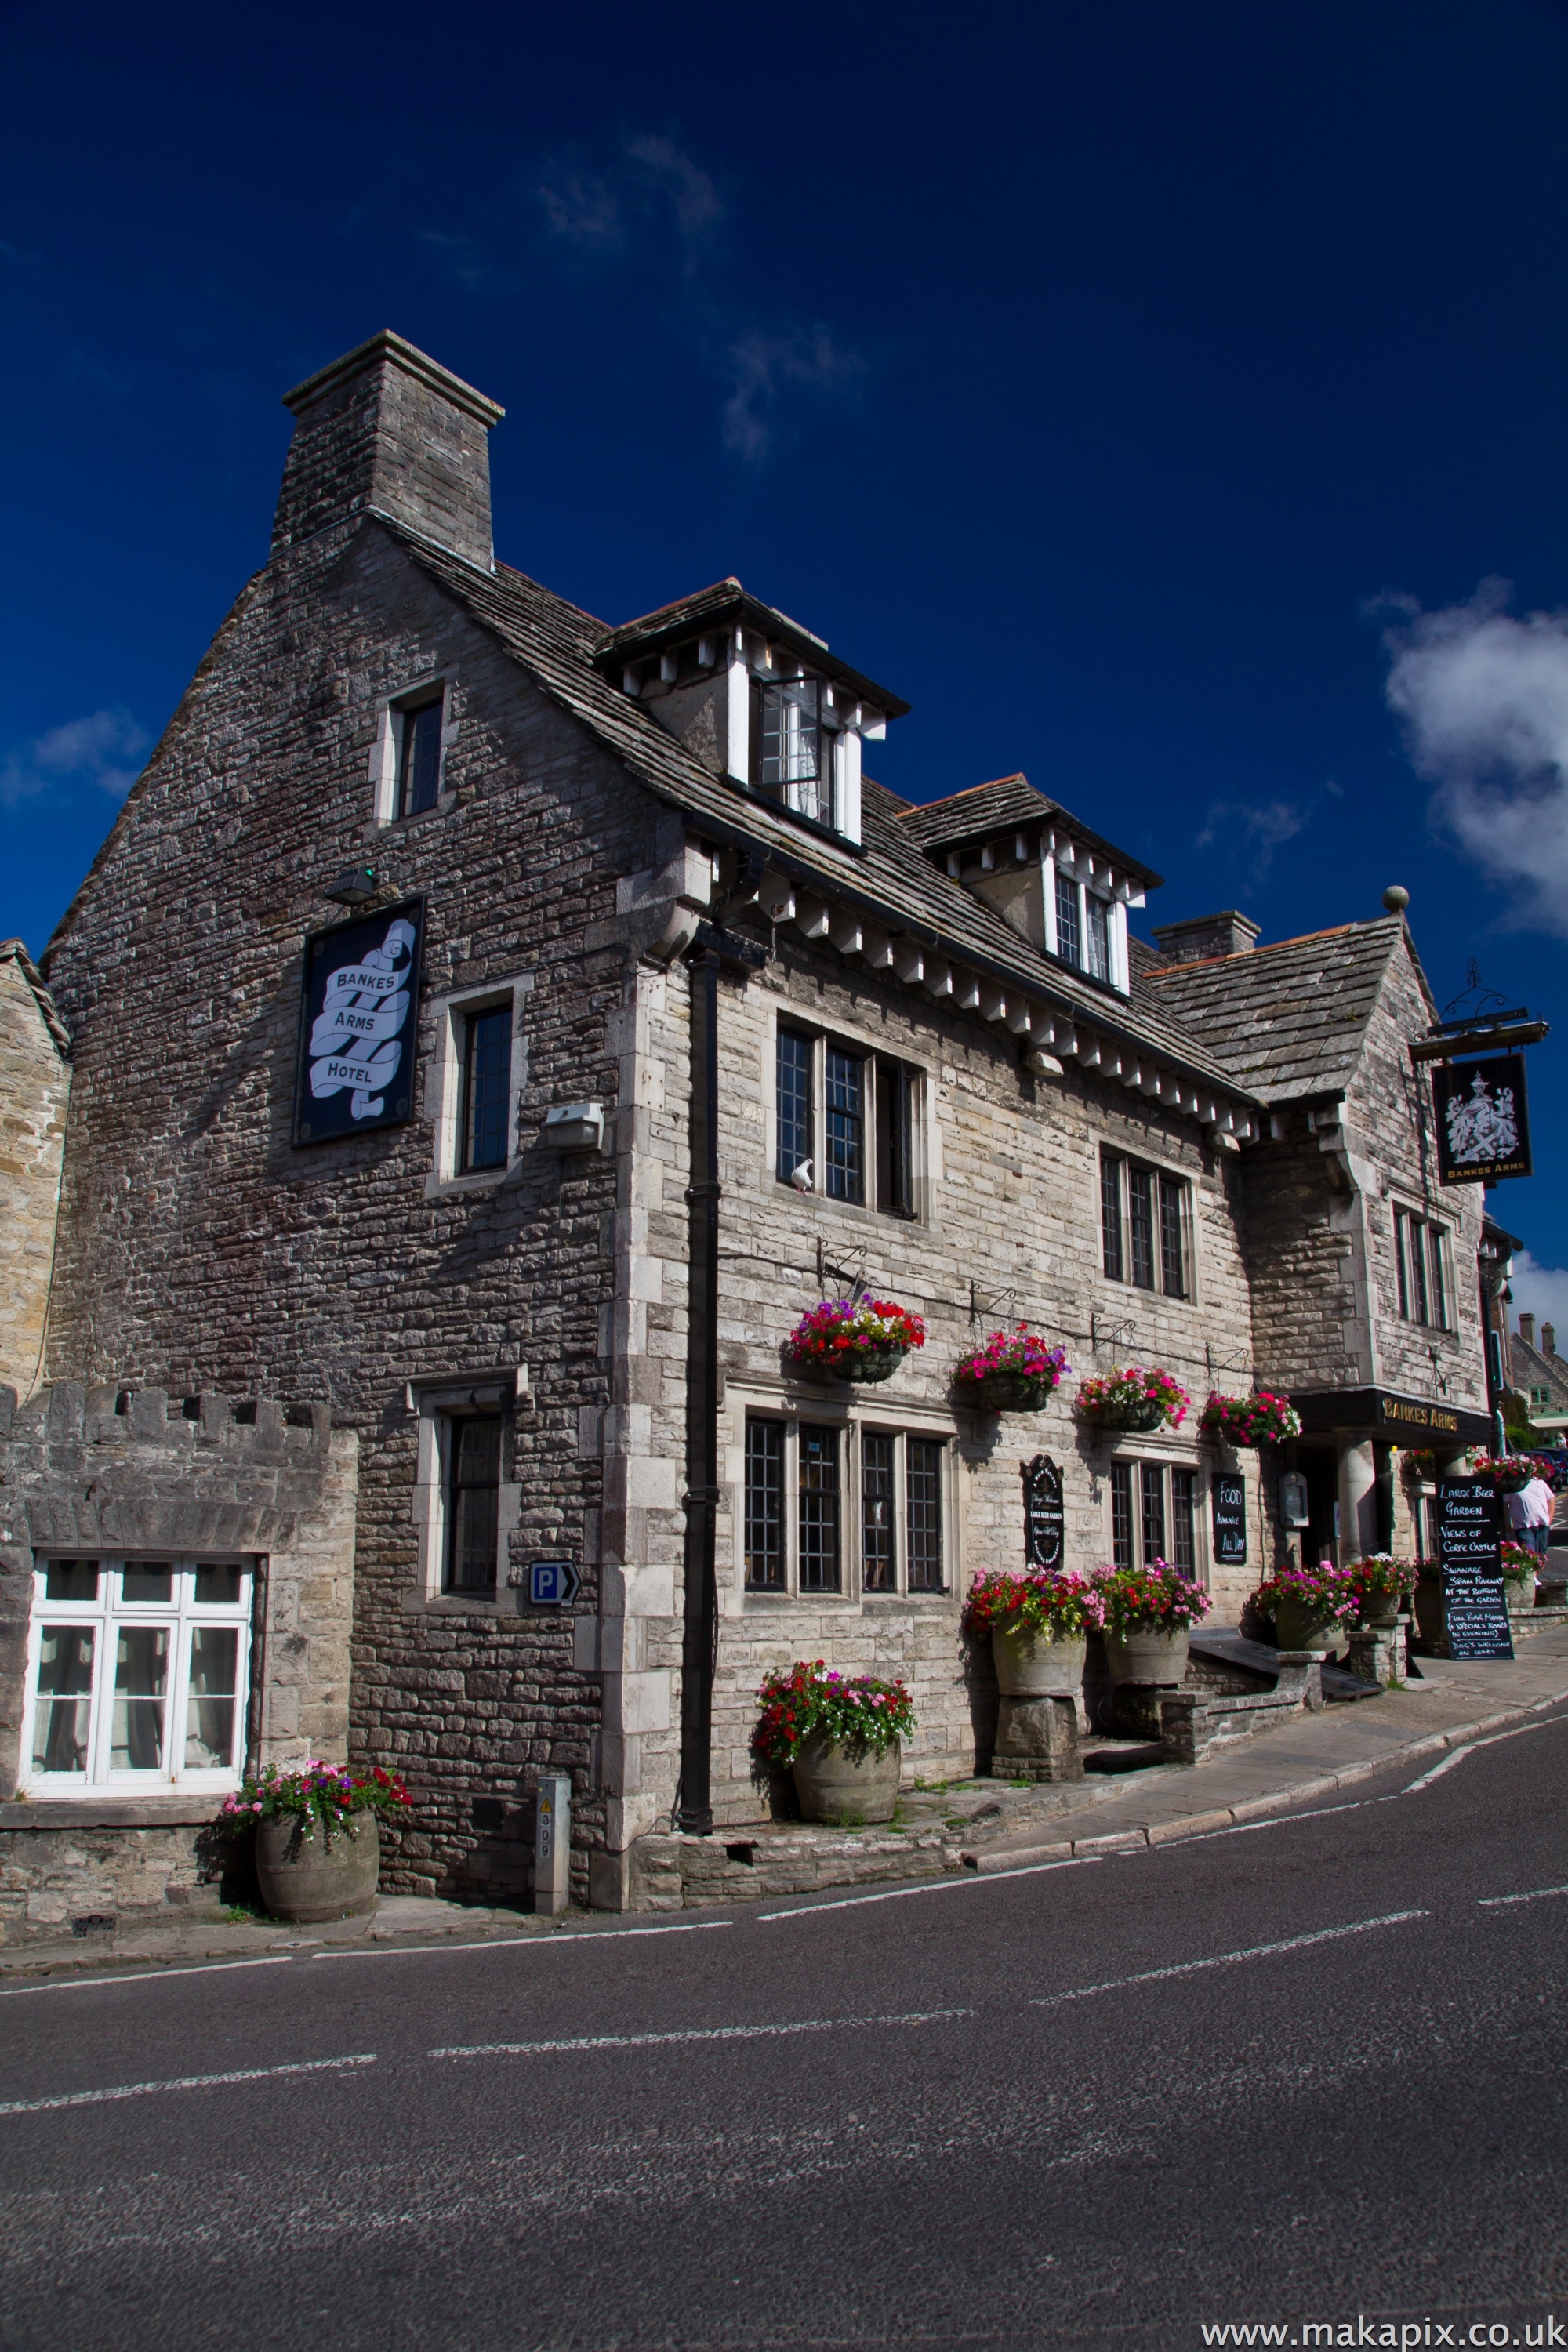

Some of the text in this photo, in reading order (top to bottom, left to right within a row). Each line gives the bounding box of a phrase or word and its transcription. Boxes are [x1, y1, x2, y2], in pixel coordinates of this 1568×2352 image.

[337, 973, 395, 989] BANKES
[334, 1011, 376, 1031] ARMS
[328, 1062, 372, 1083] HOTEL
[1447, 1162, 1525, 1178] BANKES ARMS
[1384, 1398, 1458, 1432] BANKES ARMS
[1219, 1480, 1242, 1505] FOOD
[1439, 1484, 1495, 1498] LARGE BEER
[1032, 1493, 1060, 1505] Dogs Welcome
[1446, 1501, 1483, 1516] GARDEN
[1217, 1512, 1239, 1525] AVAILABLE
[1440, 1526, 1467, 1538] VIEWS
[1222, 1532, 1245, 1552] ALL DAY
[1443, 1541, 1497, 1552] CORFE CASTLE
[1443, 1563, 1483, 1575] SWANAGE
[539, 1570, 553, 1597] P
[1449, 1576, 1504, 1586] STEAM RAILWAY
[1446, 1612, 1465, 1622] FULL
[1466, 1612, 1483, 1621] BAR
[1462, 1629, 1499, 1638] EVENING)
